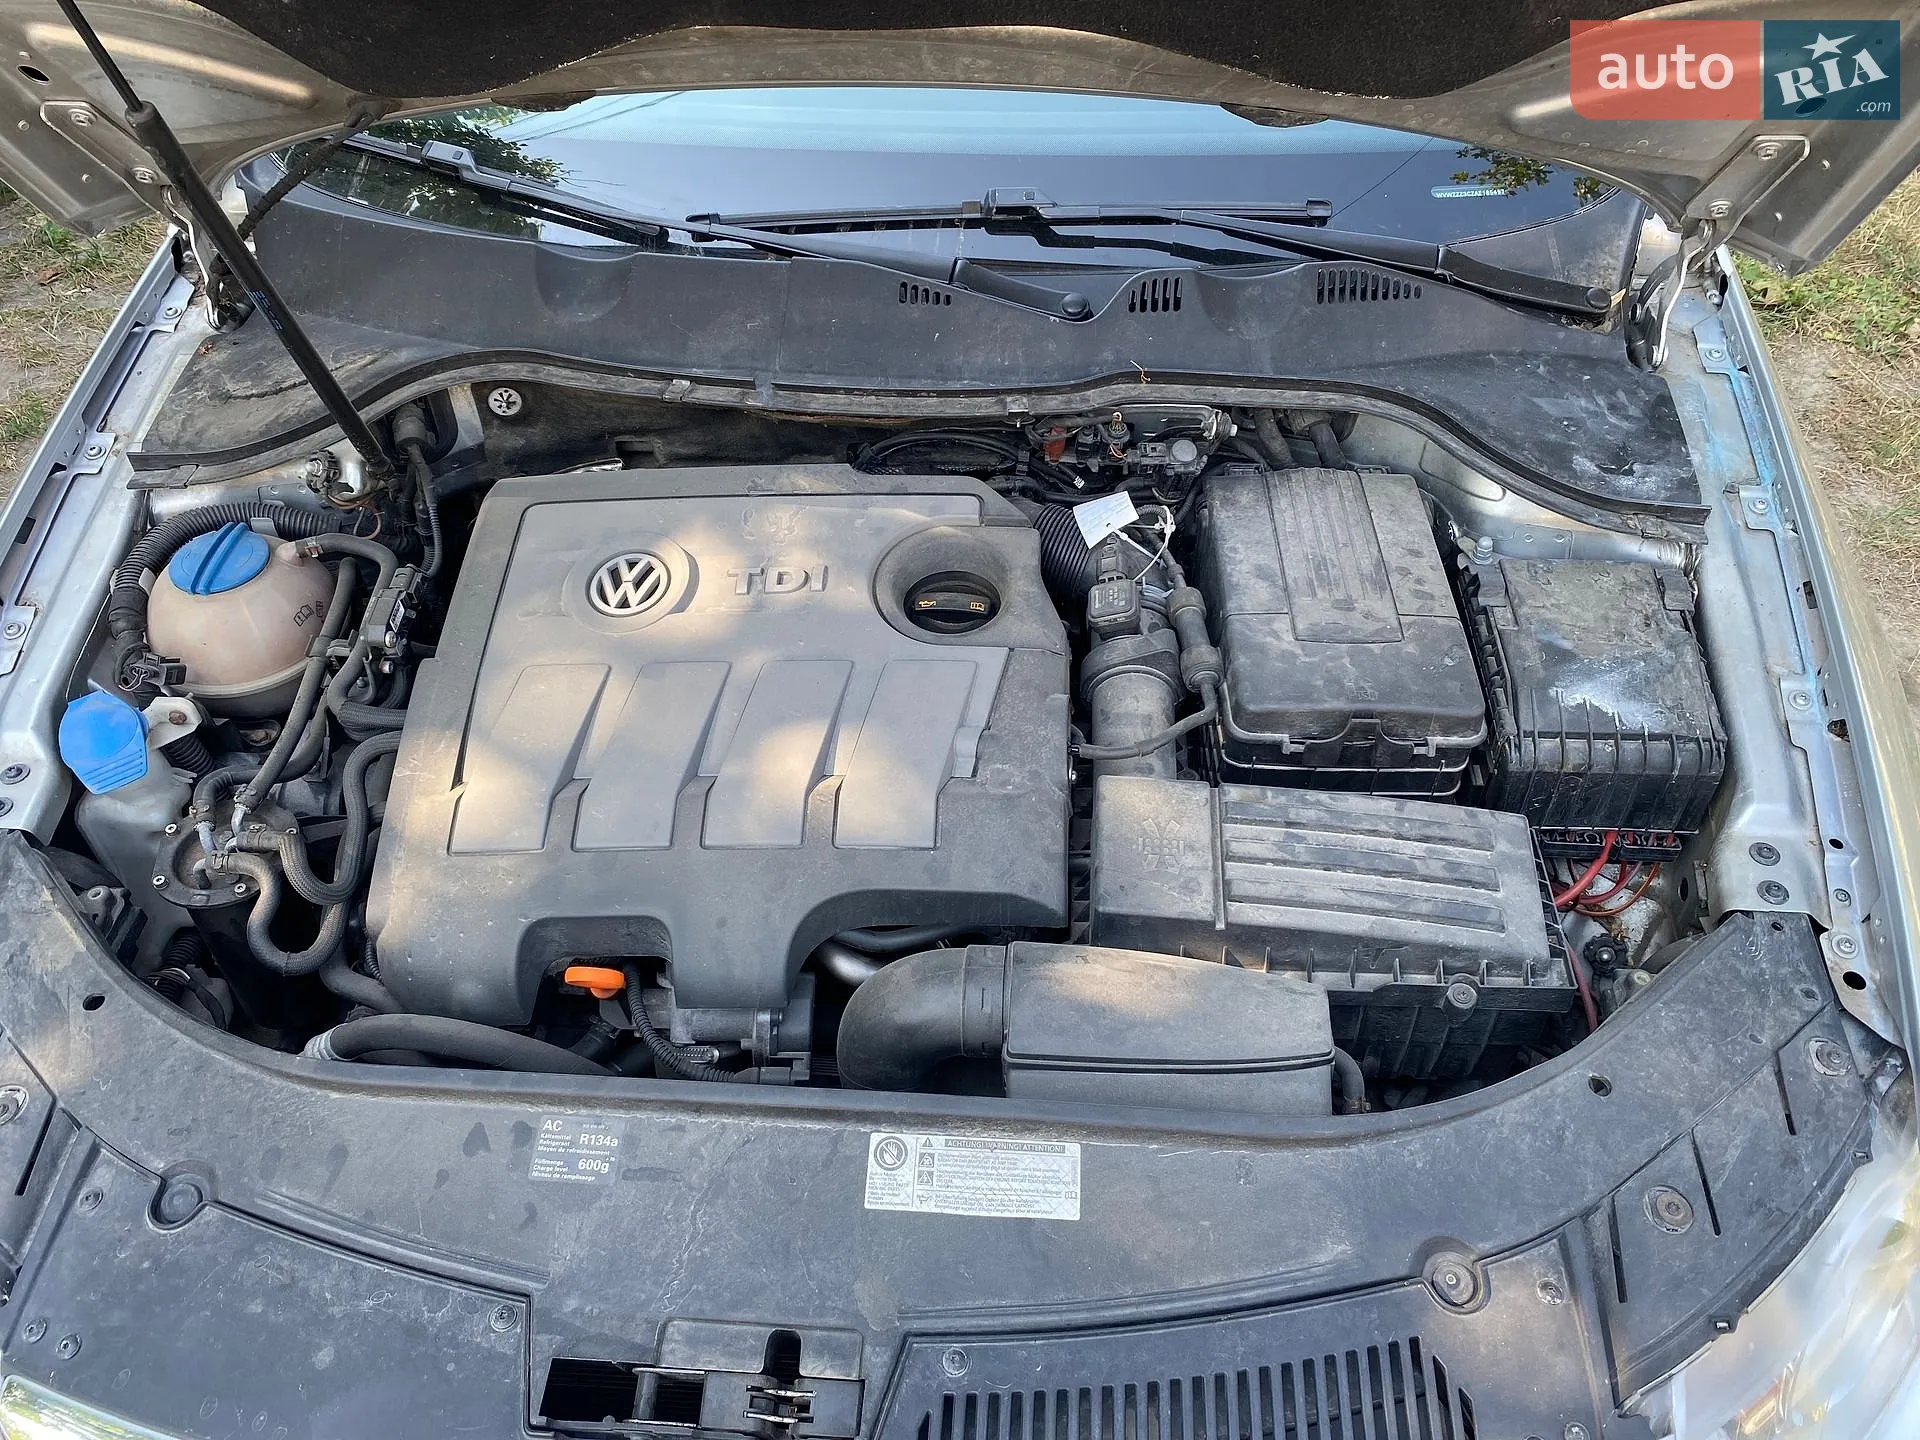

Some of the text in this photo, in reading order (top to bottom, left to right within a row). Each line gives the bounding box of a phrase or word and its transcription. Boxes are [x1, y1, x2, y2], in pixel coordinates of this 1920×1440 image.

[728, 565, 829, 596] TDI
[543, 1120, 562, 1131] AC
[580, 1133, 618, 1147] R134a
[578, 1158, 609, 1174] 600g
